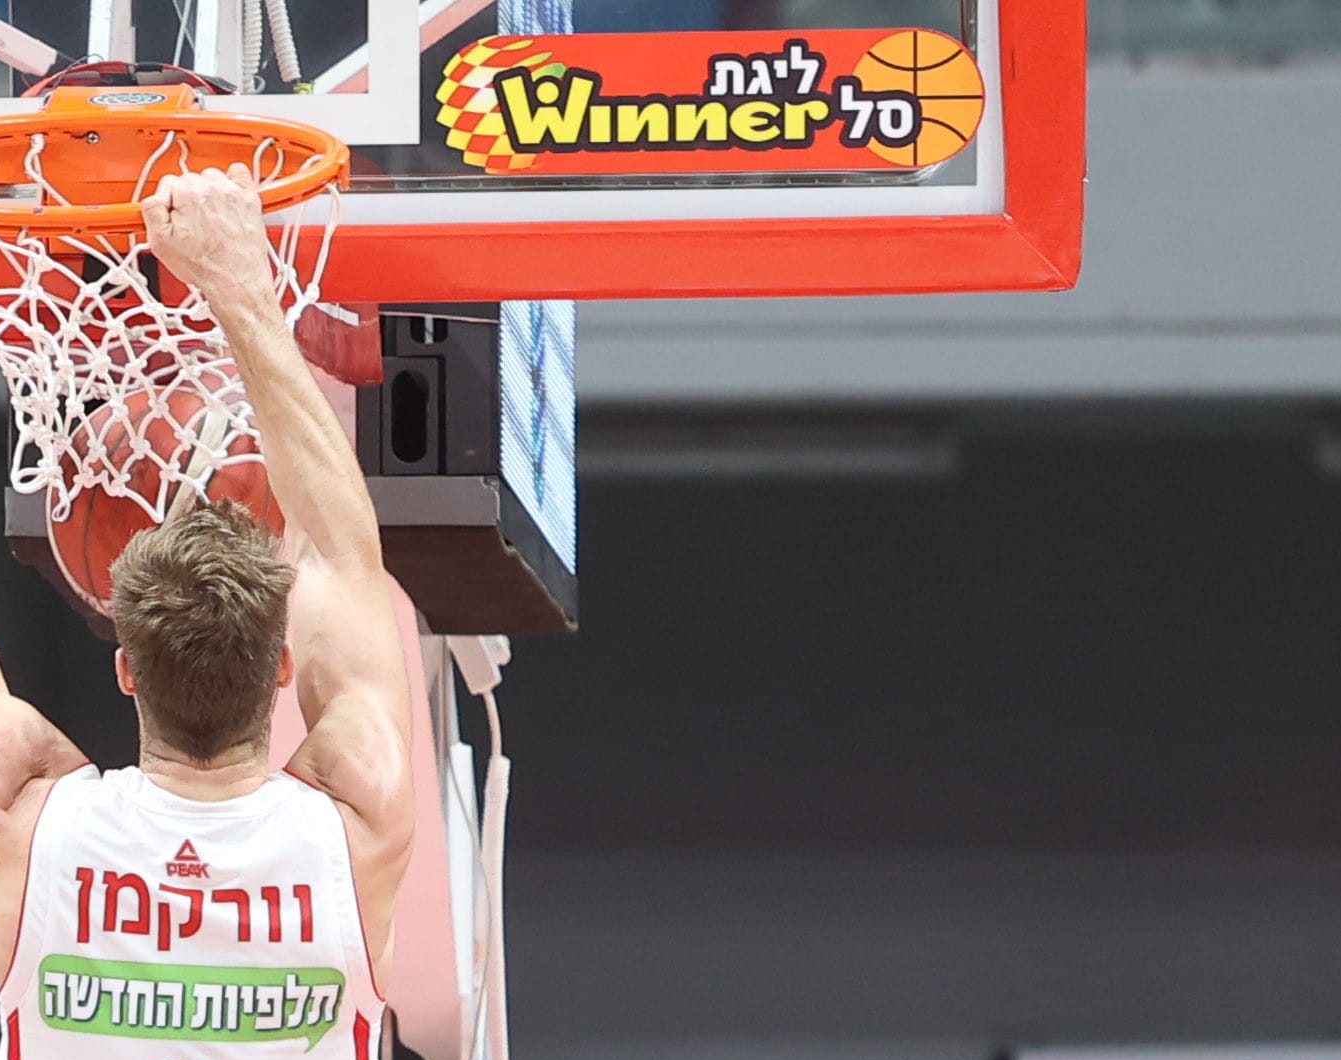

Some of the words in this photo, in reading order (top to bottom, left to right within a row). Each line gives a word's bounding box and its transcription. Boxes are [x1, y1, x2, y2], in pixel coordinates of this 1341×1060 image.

[710, 45, 822, 97] ליגת
[500, 73, 829, 146] Winner
[840, 85, 914, 139] סל
[166, 862, 211, 878] PEAK
[76, 867, 314, 951] וורקמן
[43, 971, 185, 1029] החדשה
[190, 973, 340, 1031] תלפיות
